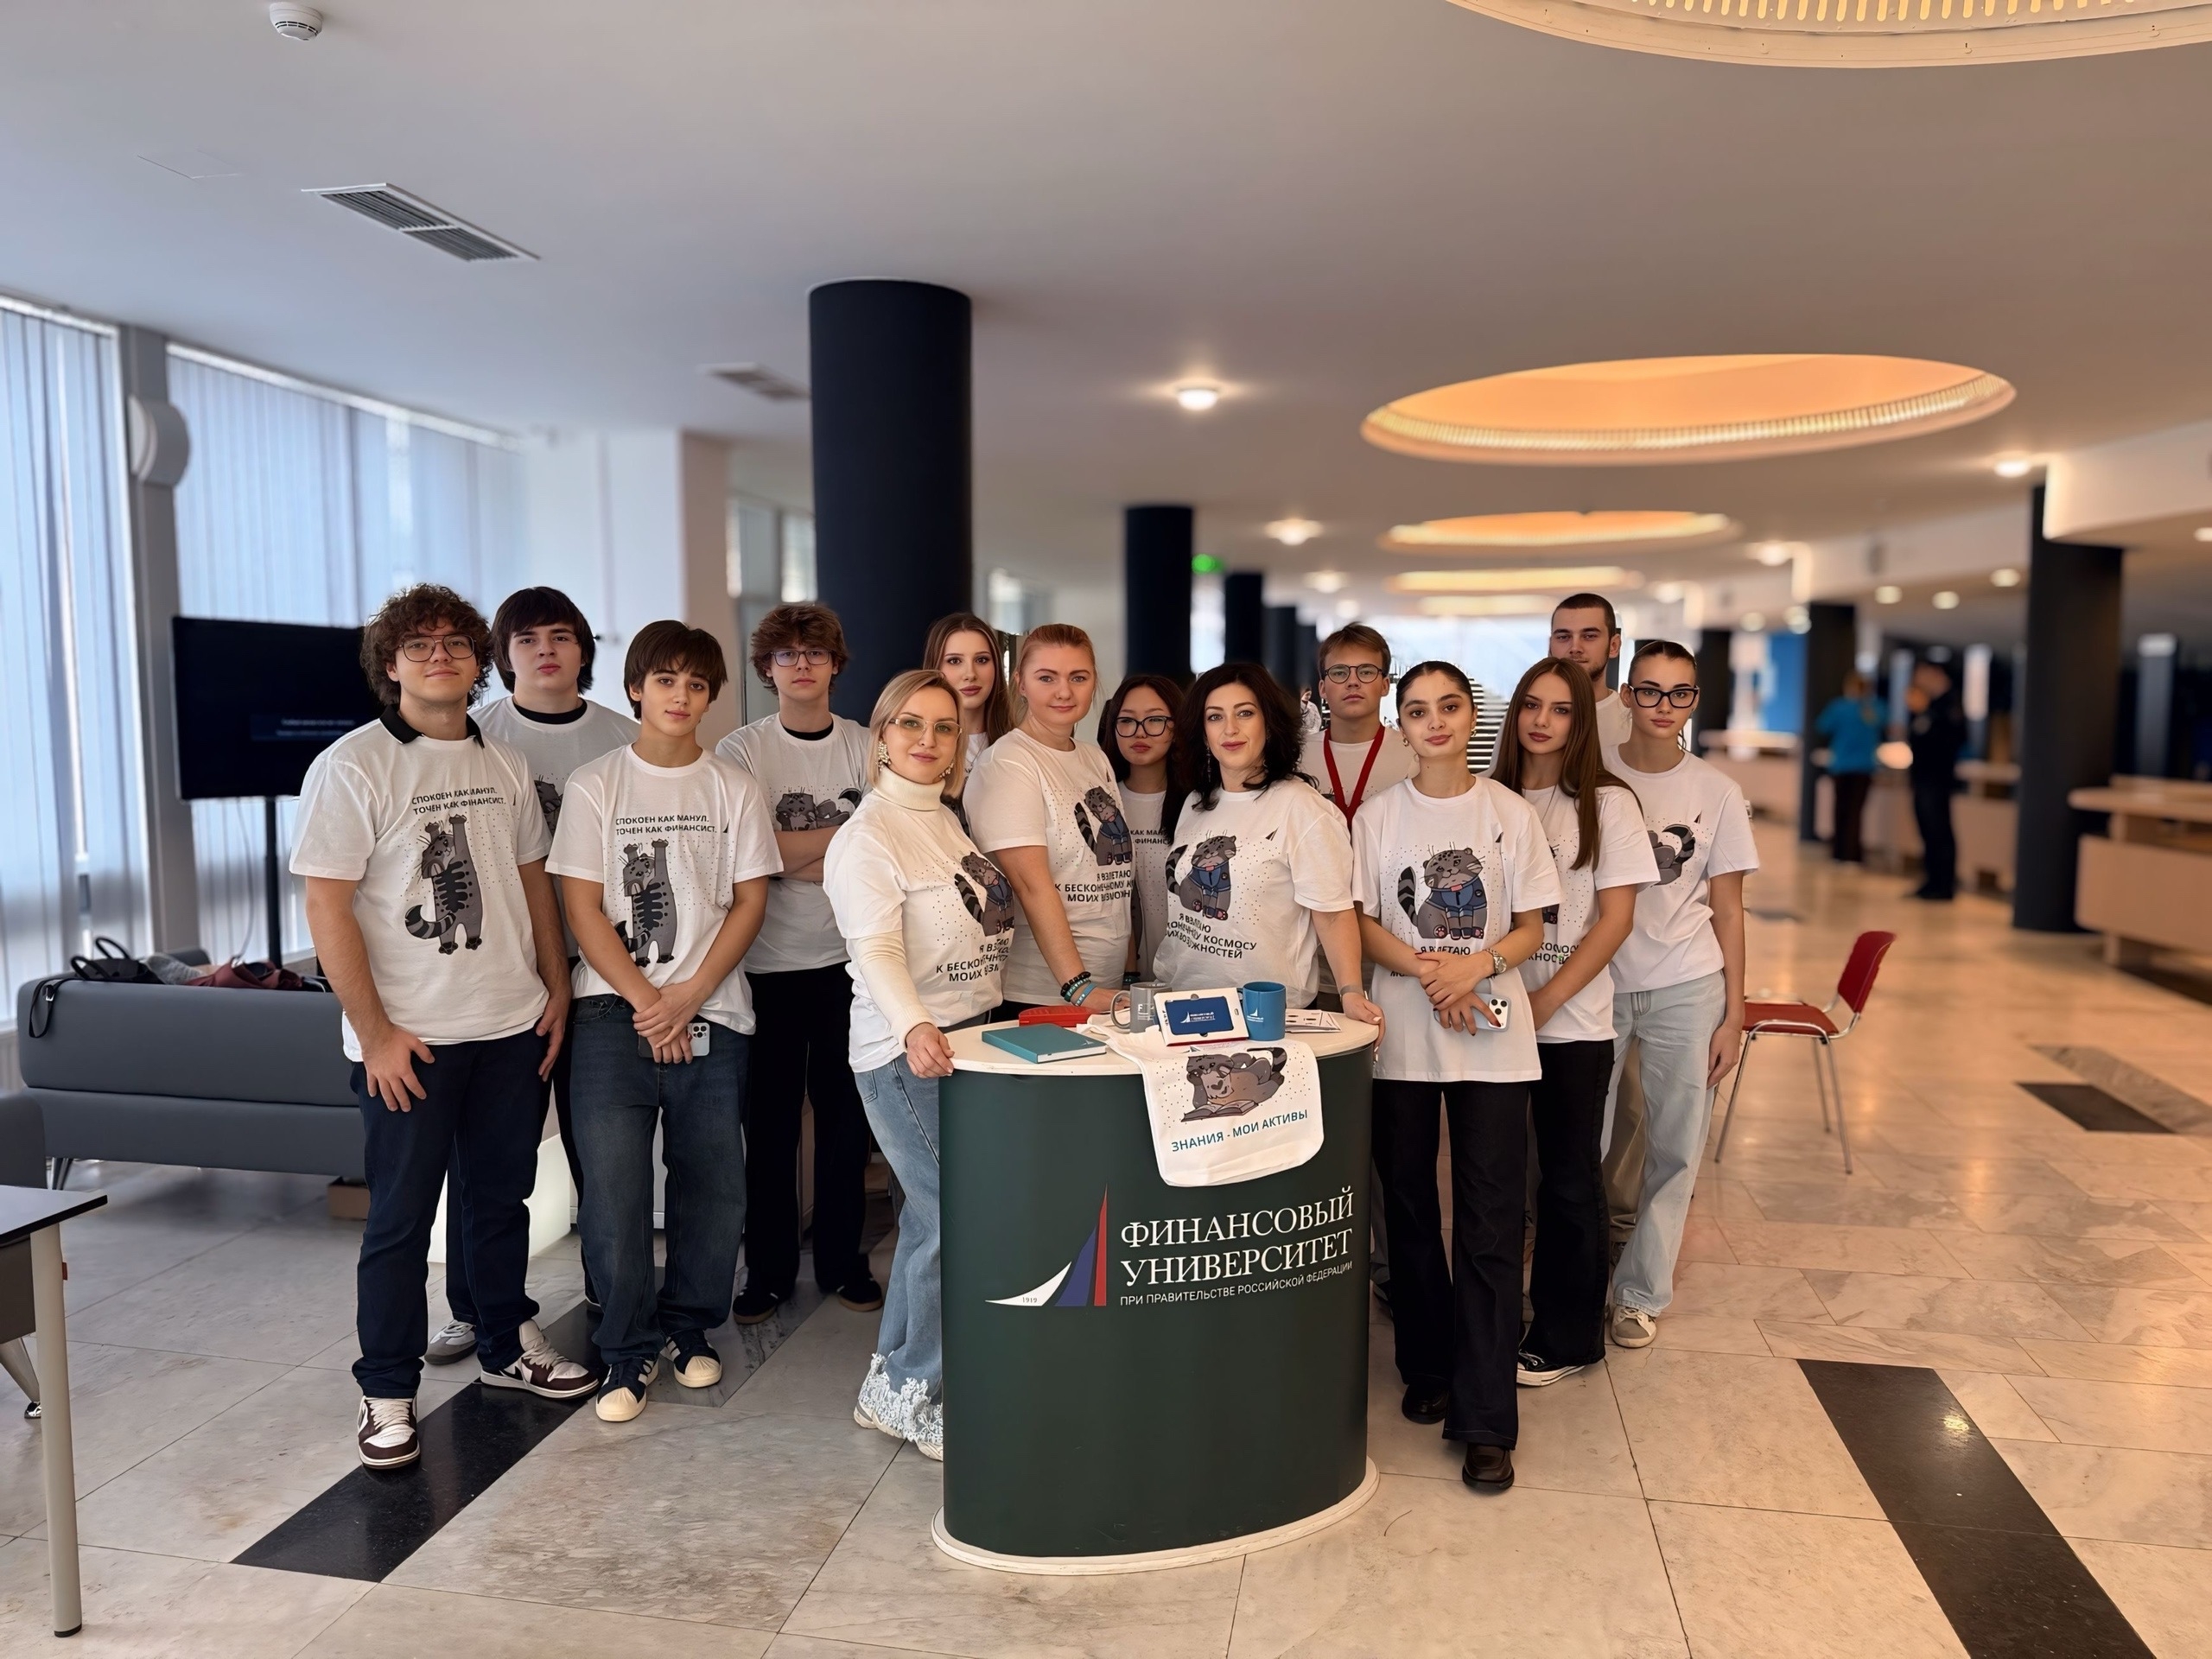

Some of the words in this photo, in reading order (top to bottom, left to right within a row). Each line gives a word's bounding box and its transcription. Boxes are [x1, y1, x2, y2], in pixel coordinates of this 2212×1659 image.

[411, 791, 452, 804] СПОКОЕН
[413, 804, 442, 815] ТОЧЕН
[443, 800, 460, 810] КАК
[616, 816, 656, 826] СПОКОЕН
[616, 827, 643, 836] ТОЧЕН
[1067, 893, 1099, 903] МОИХ
[1204, 935, 1257, 950] КОСМОСУ
[936, 964, 944, 973] К
[949, 969, 982, 982] МОИХ
[1171, 1131, 1224, 1152] ЗНАНИЯ
[1232, 1122, 1259, 1138] МОИ
[1262, 1109, 1308, 1129] АКТИВЫ
[1121, 1185, 1354, 1248] ФИНАНСОВЫЙ
[1120, 1228, 1353, 1287] УНИВЕРСИТЕТ
[1120, 1295, 1143, 1306] ПРИ
[1147, 1286, 1236, 1304] ПРАВИТЕЛЬСТВЕ
[1237, 1274, 1305, 1295] РОССИЙСКОЙ
[1306, 1261, 1353, 1283] ФЕДЕРАЦИИ
